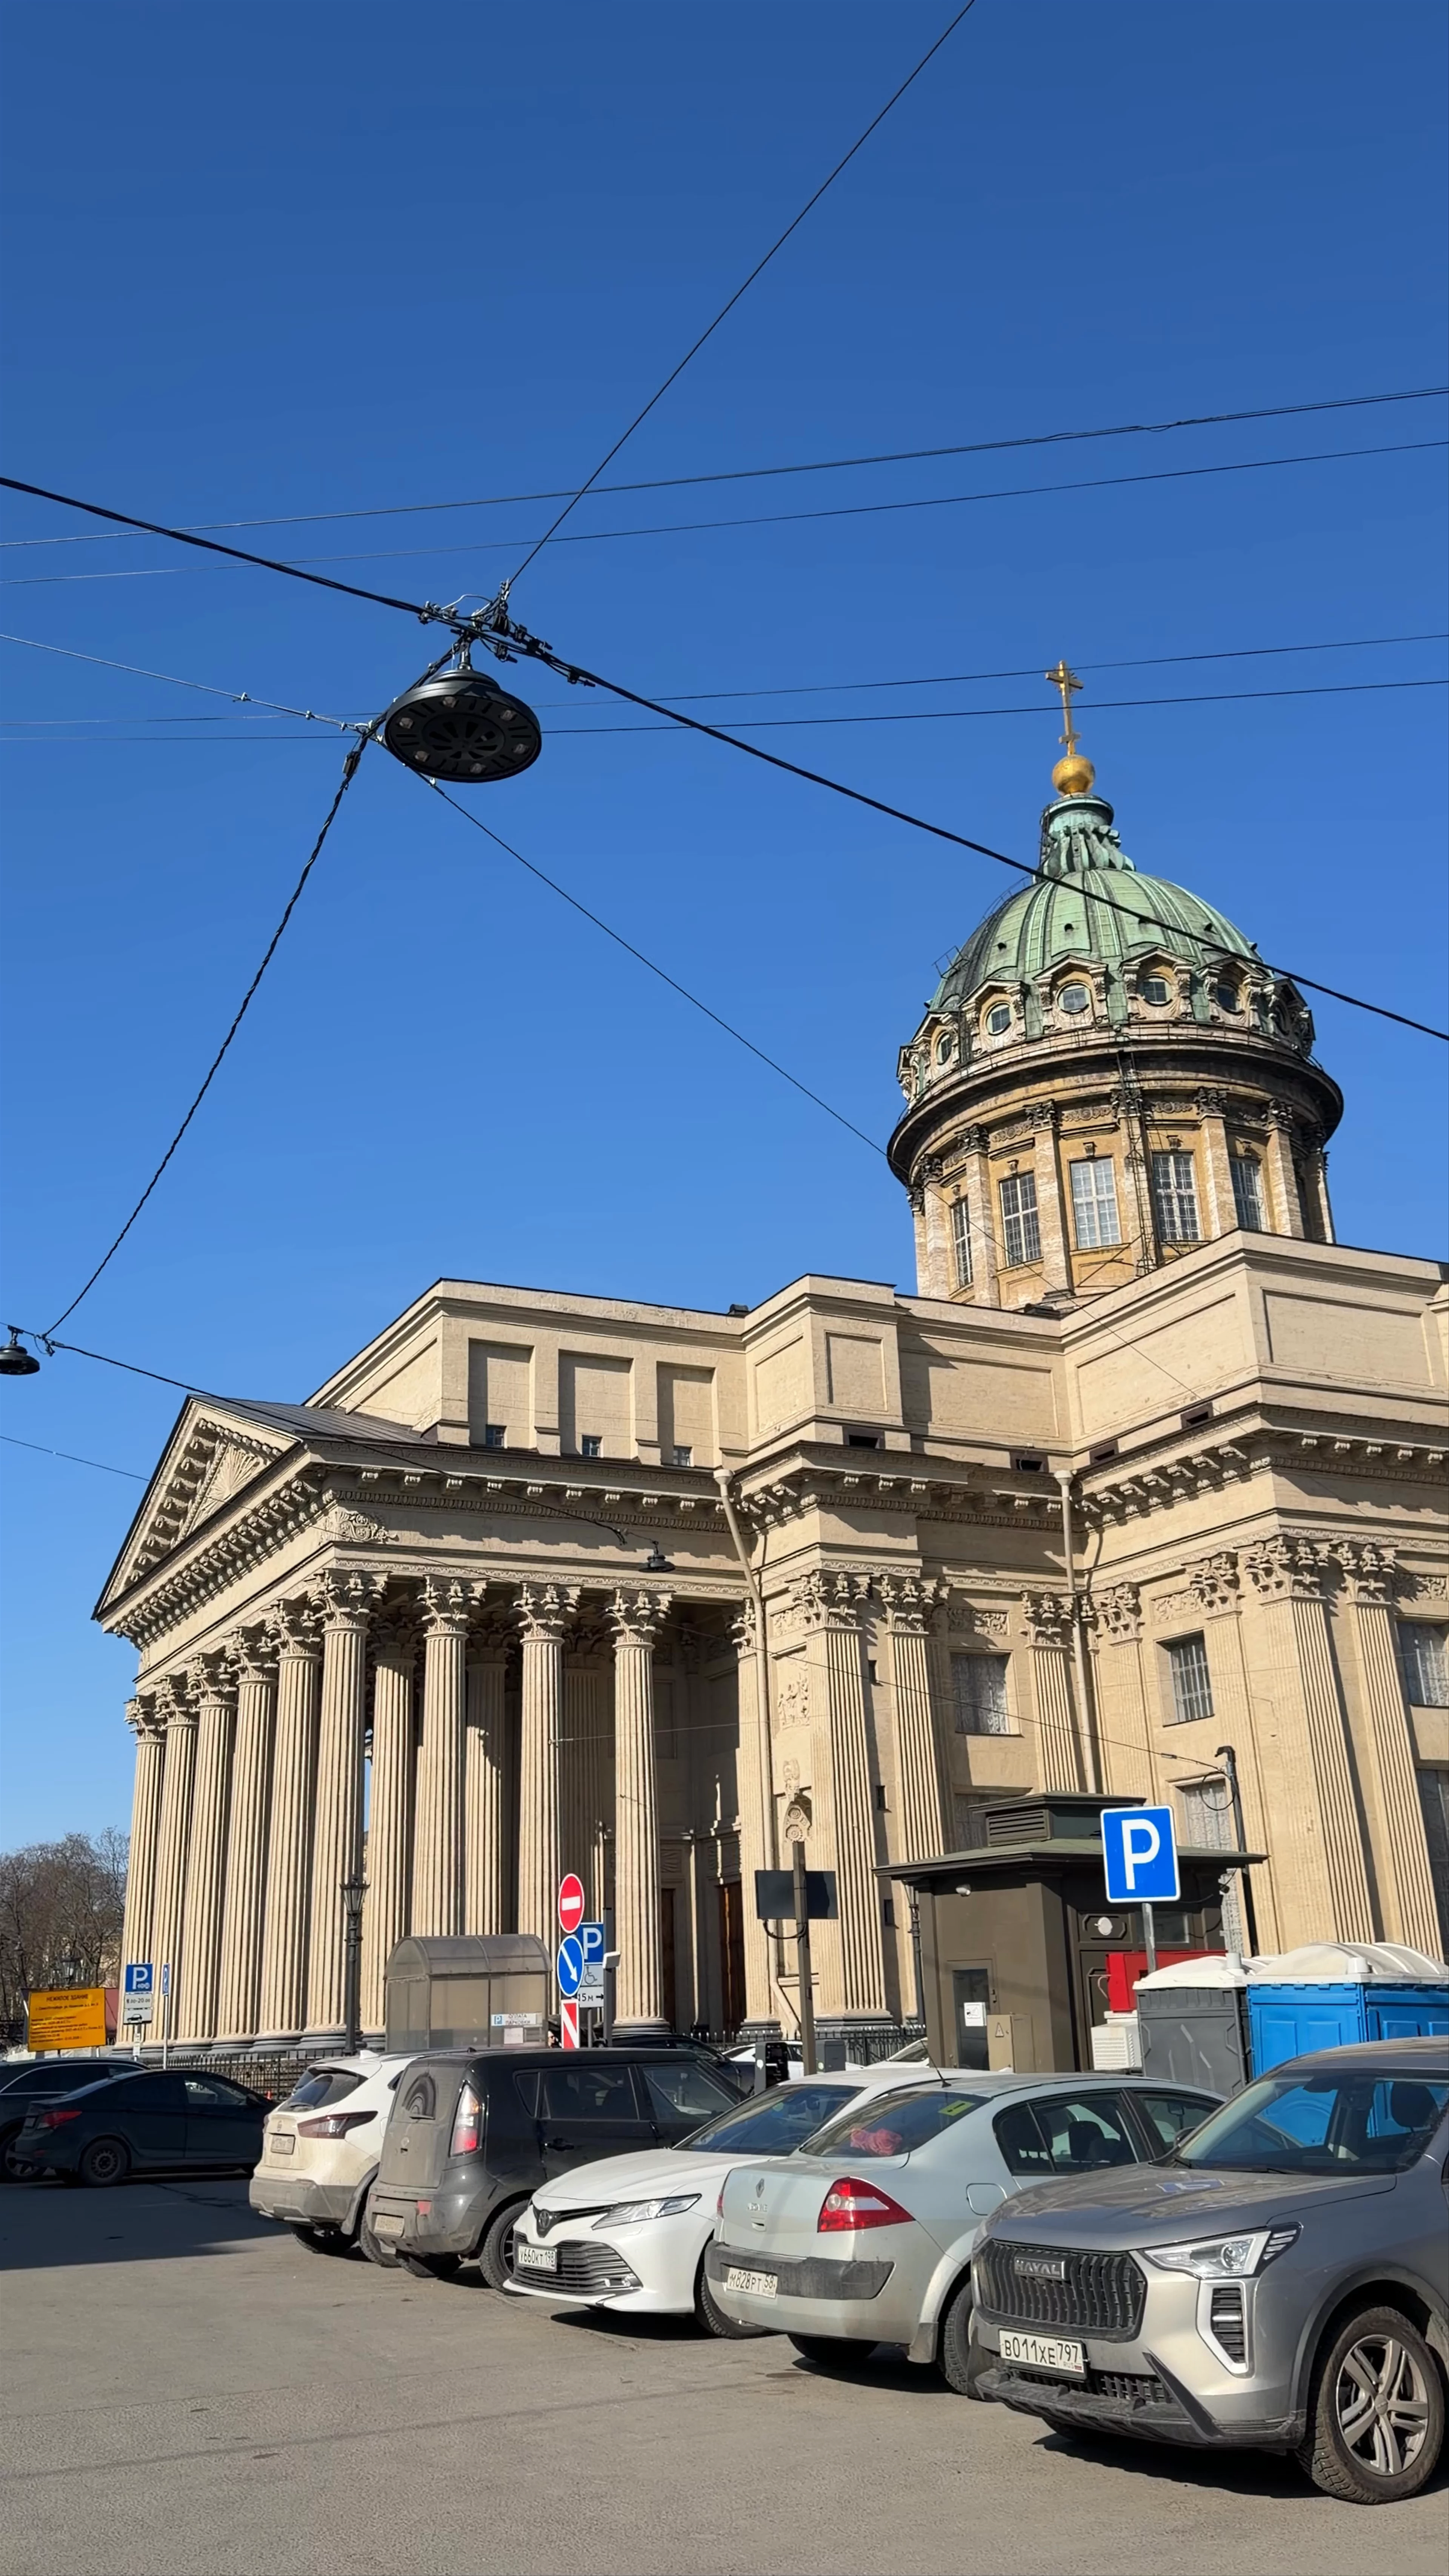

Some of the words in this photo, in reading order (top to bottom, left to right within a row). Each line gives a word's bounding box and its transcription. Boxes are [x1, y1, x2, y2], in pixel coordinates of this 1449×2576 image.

[1121, 1819, 1160, 1890] P
[583, 1928, 602, 1959] P
[132, 1967, 148, 1990] P
[1016, 2260, 1060, 2275] HAVAL
[730, 2271, 762, 2292] М828РТ
[1004, 2336, 1056, 2365] В011ХЕ
[1057, 2342, 1078, 2363] 797
